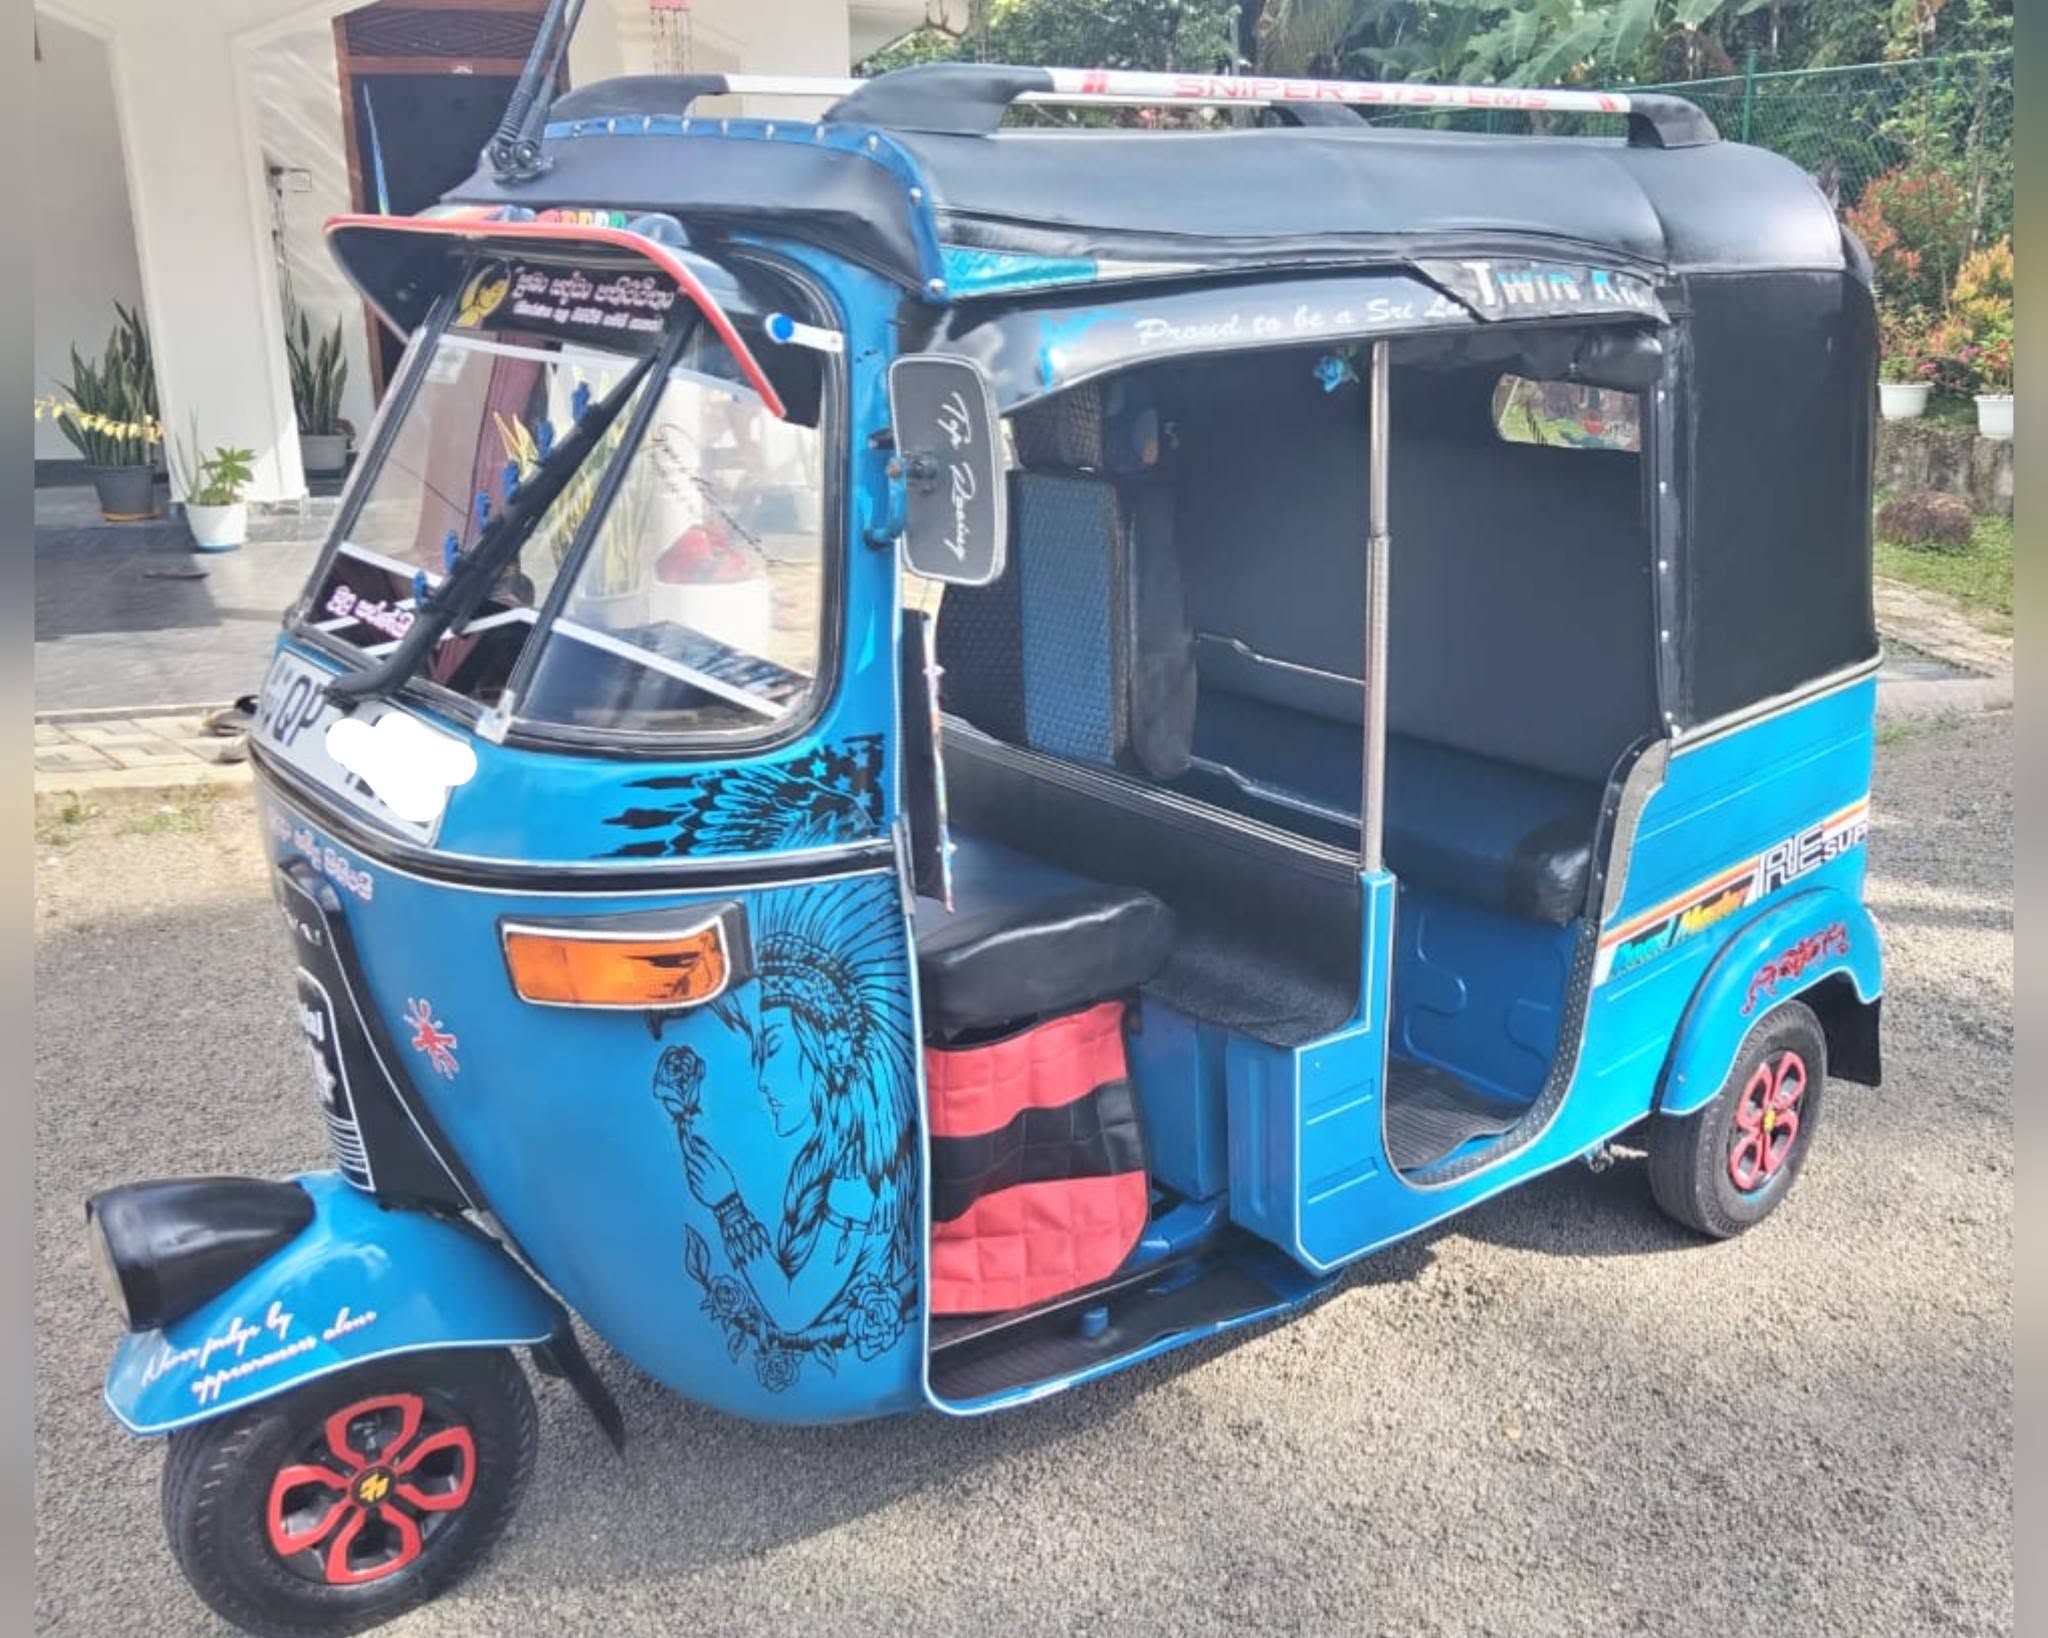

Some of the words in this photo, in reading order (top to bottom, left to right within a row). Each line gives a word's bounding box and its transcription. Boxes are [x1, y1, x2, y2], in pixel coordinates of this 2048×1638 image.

[1176, 78, 1342, 99] SNIPER
[1133, 314, 1243, 345] Proud
[1251, 314, 1281, 335] to
[1293, 304, 1323, 328] be
[1334, 309, 1355, 324] a
[1366, 297, 1413, 322] Sri
[936, 392, 973, 450] Top
[943, 461, 977, 562] Racing
[141, 1344, 201, 1388] Never
[199, 1316, 261, 1369] judge
[266, 1300, 295, 1341] by
